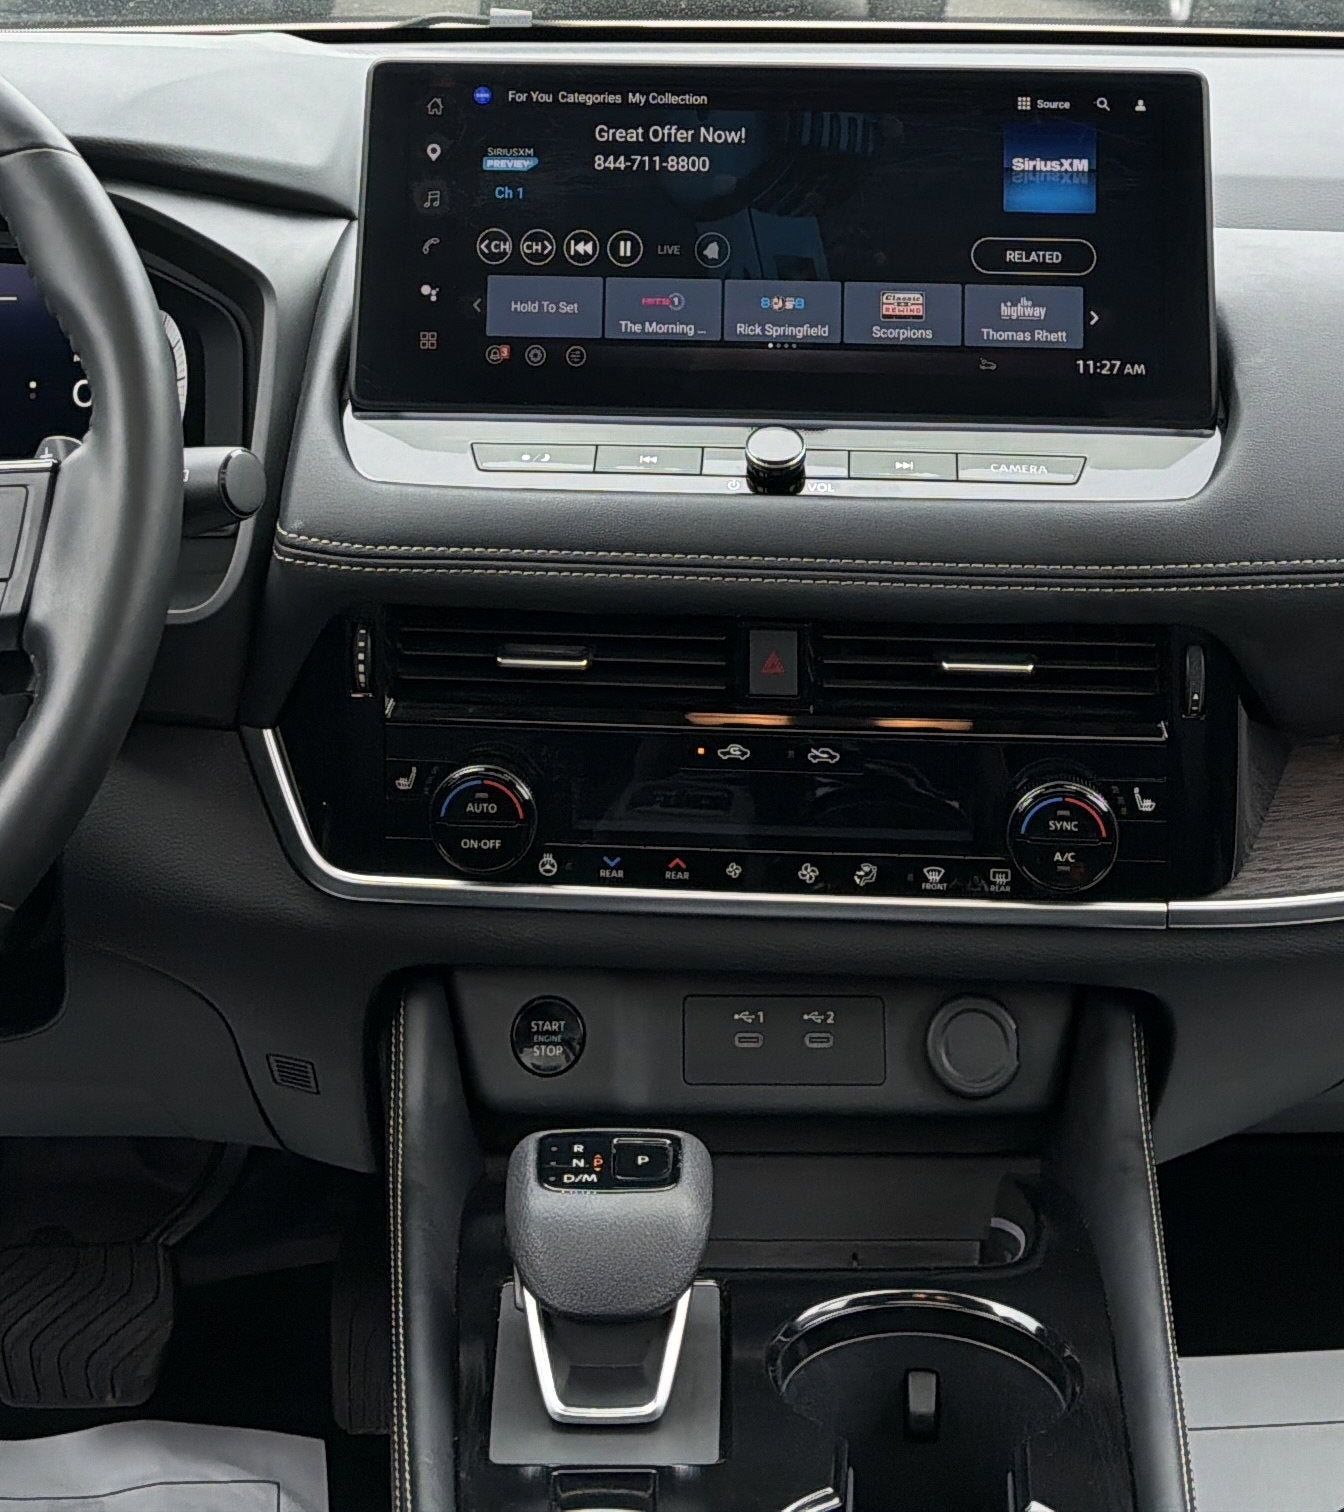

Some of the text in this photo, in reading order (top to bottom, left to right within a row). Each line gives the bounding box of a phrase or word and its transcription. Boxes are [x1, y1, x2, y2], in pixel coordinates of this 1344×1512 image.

[508, 91, 708, 106] For You Categories My Collection
[1036, 99, 1071, 110] Source
[594, 124, 747, 144] Great Offer Now!
[593, 155, 710, 172] 844-711-8800
[1011, 157, 1089, 172] SiriusXM
[494, 186, 525, 199] Ch 1
[490, 241, 510, 253] CH
[523, 241, 542, 254] CH
[657, 244, 681, 255] LIVE
[1005, 250, 1063, 264] RELATED
[510, 301, 579, 314] Hold To Set
[999, 302, 1047, 320] highway
[619, 320, 643, 333] The
[644, 321, 695, 337] Morning
[736, 322, 829, 340] Rick Springfield
[871, 325, 934, 341] Scorpions
[981, 328, 1067, 343] Thomas Rhett
[1075, 359, 1147, 376] 11:27 AM
[990, 463, 1049, 475] CAMERA
[807, 482, 835, 493] VOL
[465, 802, 498, 814] AUTO
[1048, 820, 1079, 832] SYNC
[1053, 851, 1076, 863] A/C
[599, 868, 624, 879] REAR
[665, 870, 690, 880] REAR
[921, 882, 948, 891] FRONT
[989, 883, 1011, 893] REAR
[826, 1011, 835, 1024] 2
[530, 1020, 566, 1033] START
[533, 1034, 562, 1043] ENGINE
[532, 1045, 564, 1057] STOP
[573, 1144, 585, 1154] R
[572, 1158, 585, 1168] N
[637, 1155, 650, 1166] P
[563, 1172, 598, 1184] D/M
